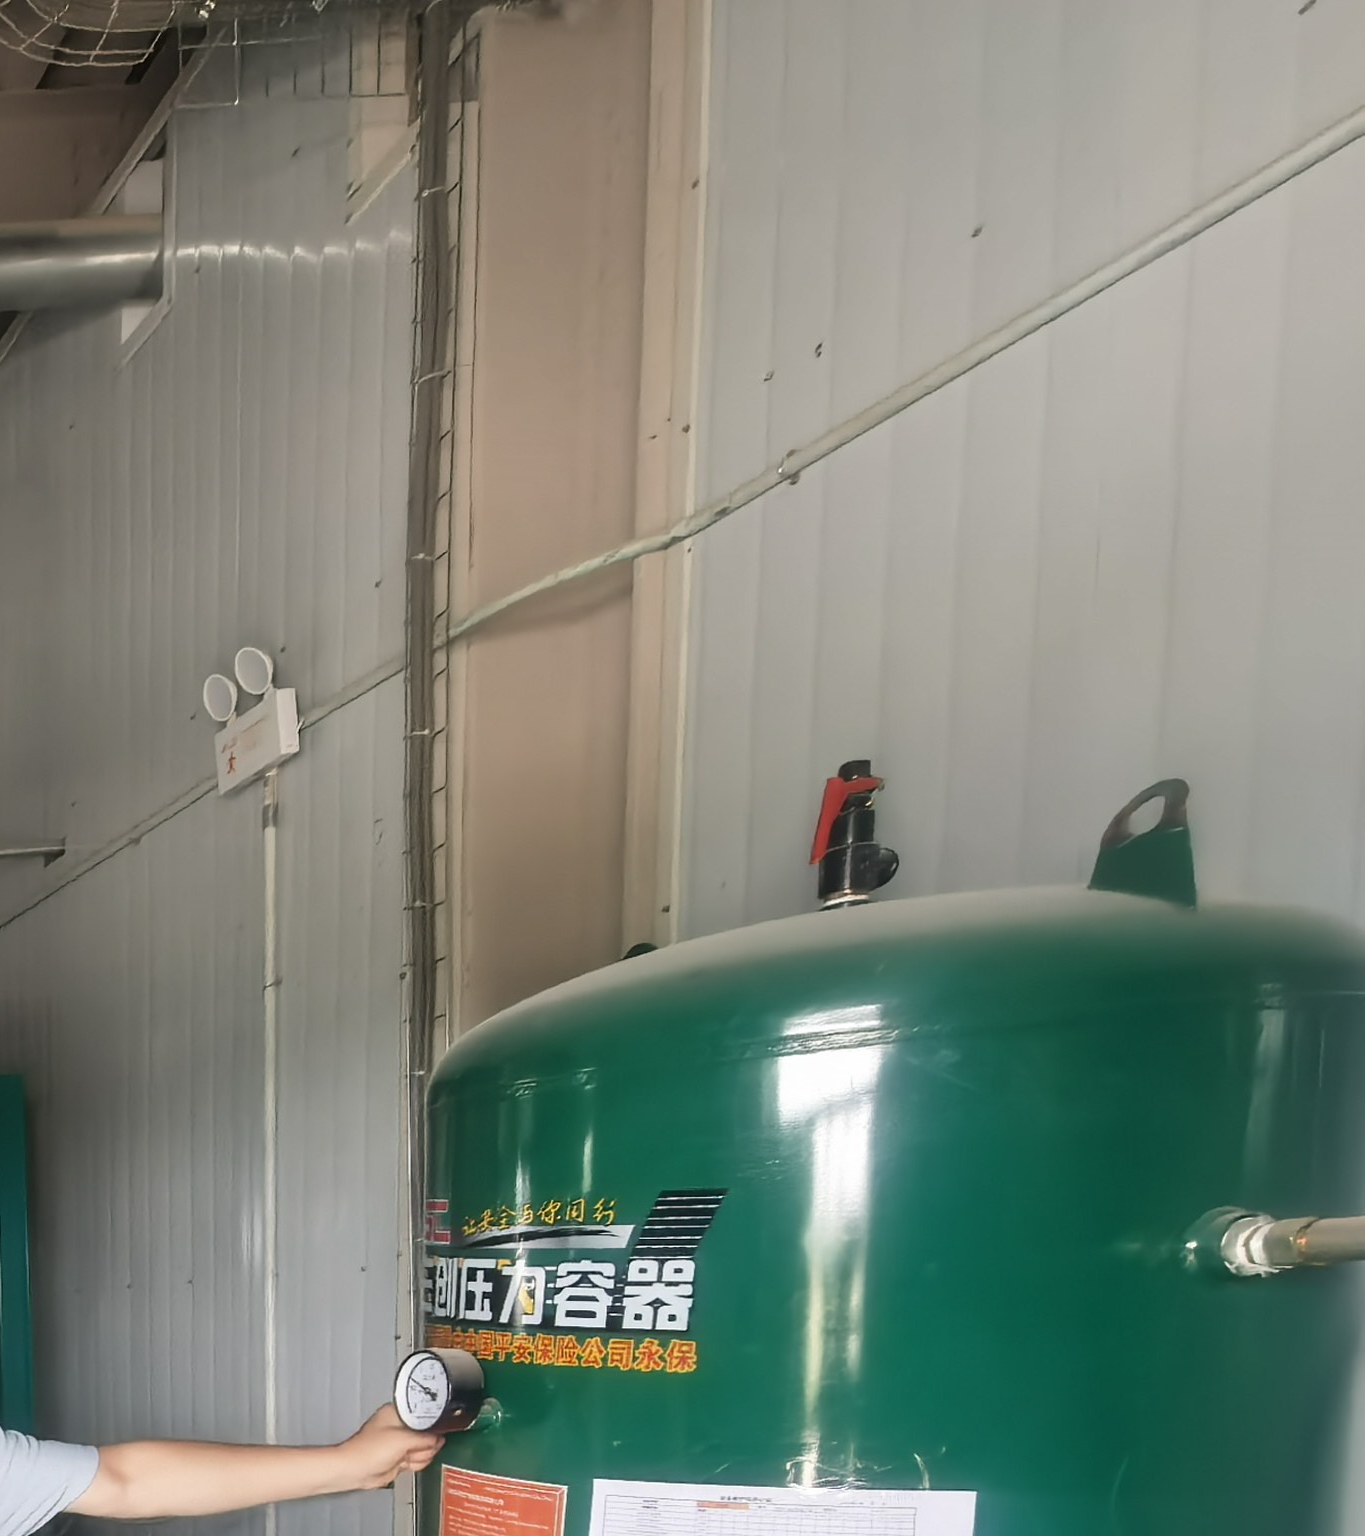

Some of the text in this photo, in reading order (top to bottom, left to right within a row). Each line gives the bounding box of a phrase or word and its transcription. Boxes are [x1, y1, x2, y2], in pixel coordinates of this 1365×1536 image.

[462, 1198, 618, 1237] 让安全与你同行
